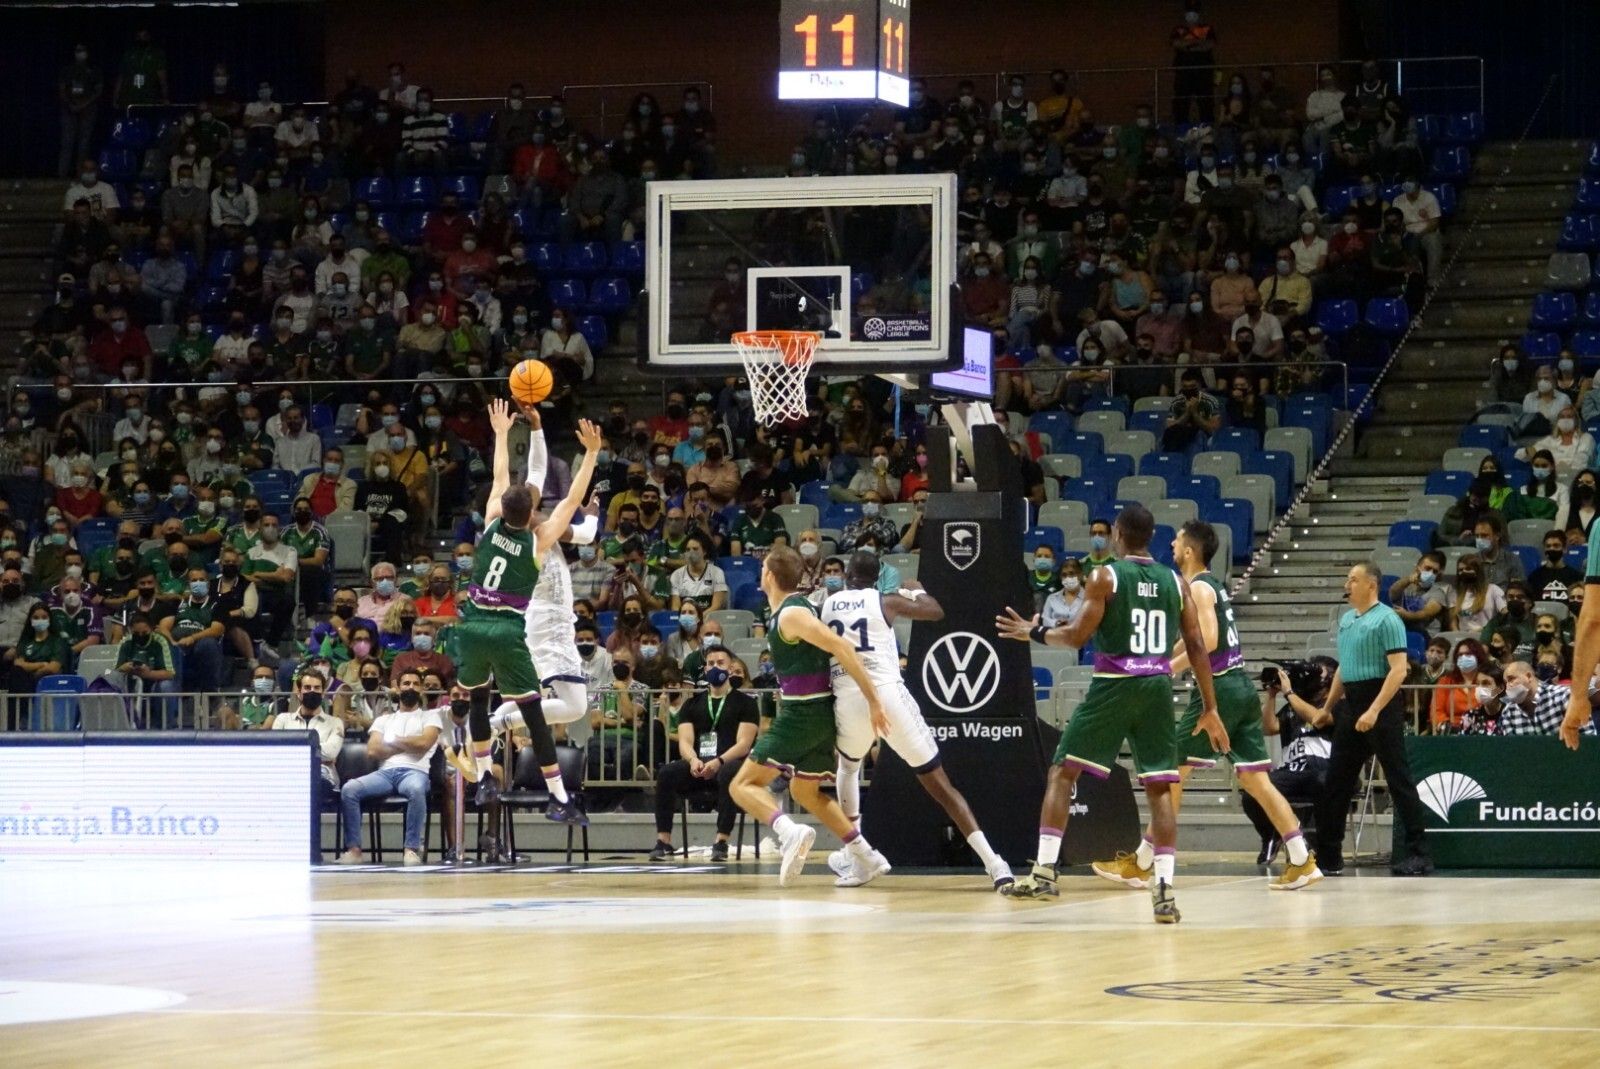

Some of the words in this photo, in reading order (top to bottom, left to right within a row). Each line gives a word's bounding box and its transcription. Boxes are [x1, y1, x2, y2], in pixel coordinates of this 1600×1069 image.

[794, 14, 855, 67] 11
[883, 17, 904, 74] 11
[482, 555, 507, 592] 8
[1542, 590, 1568, 600] FILA
[1130, 608, 1167, 654] 30
[962, 723, 1023, 742] Wagen
[111, 805, 220, 837] Banco
[1479, 801, 1600, 821] Fundació
